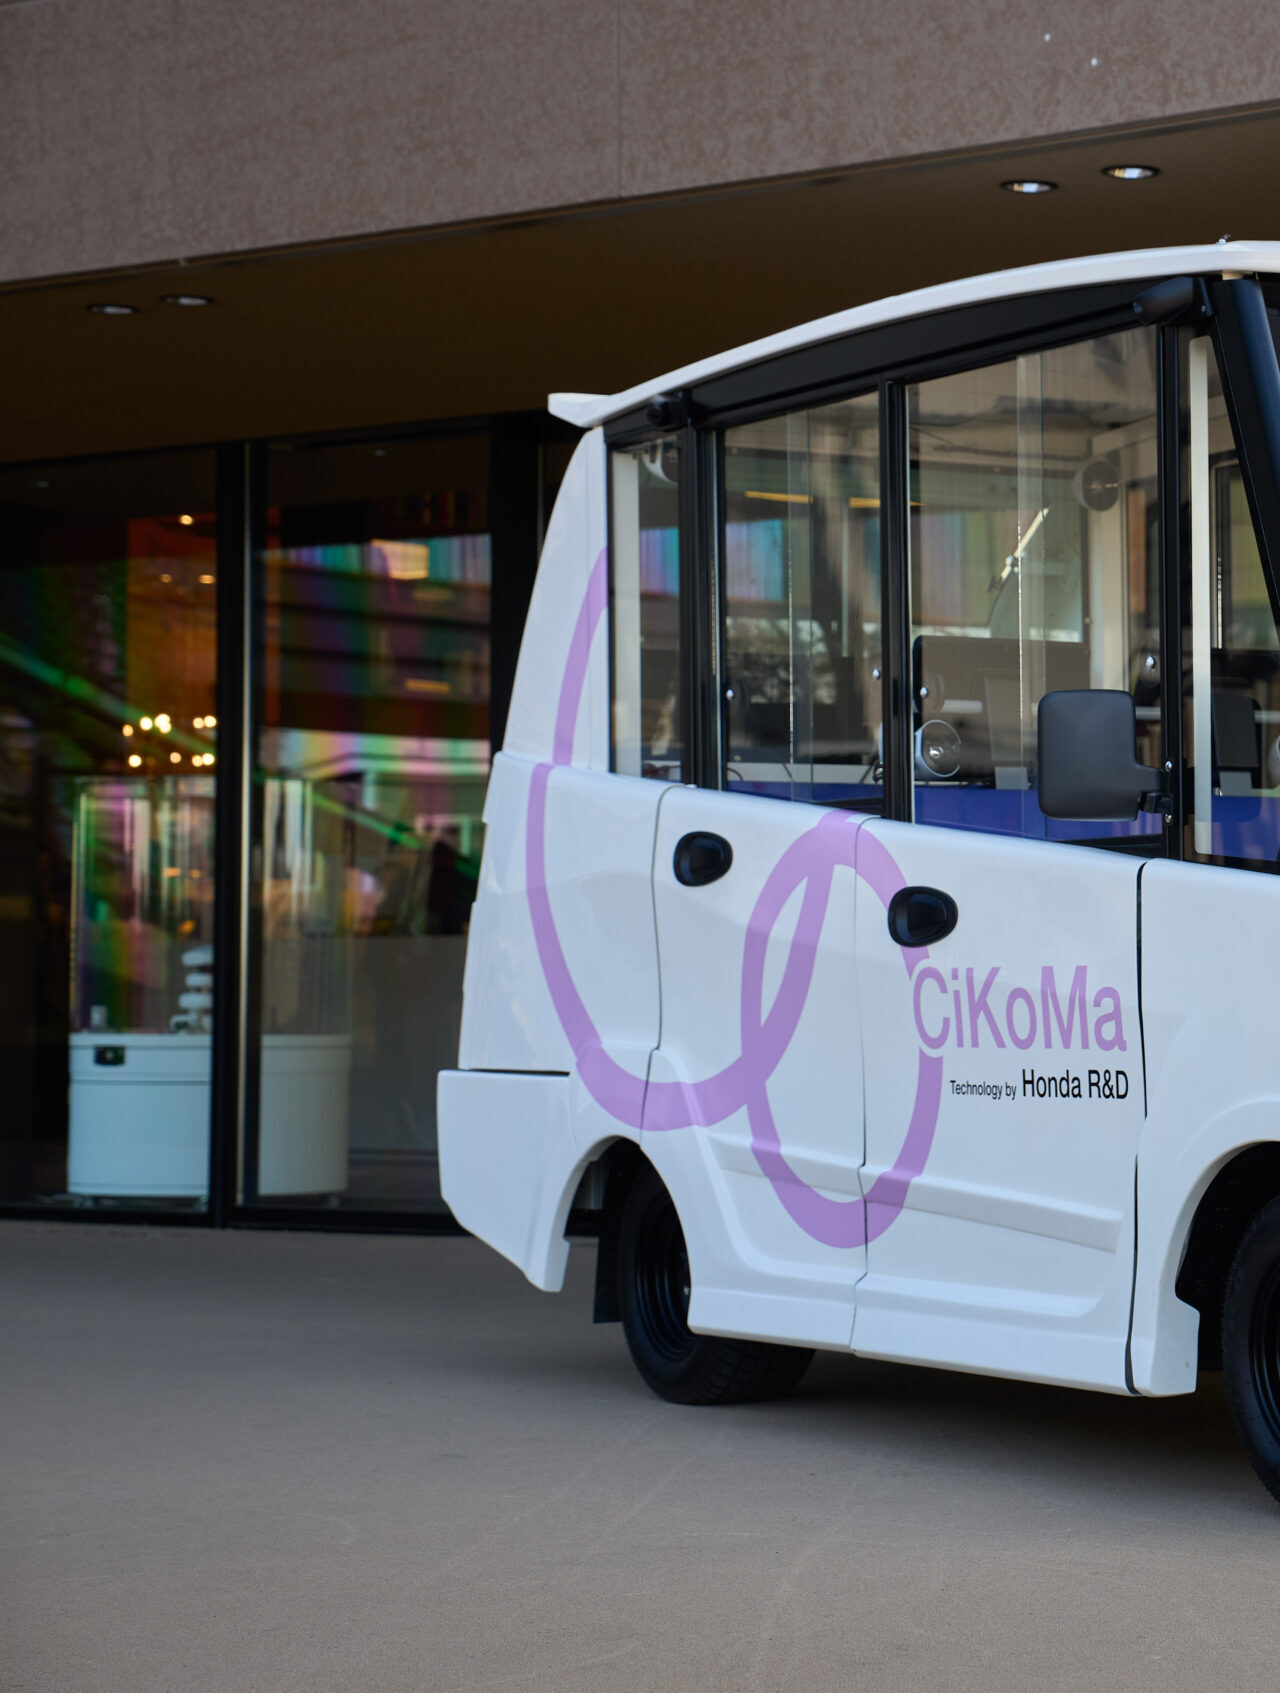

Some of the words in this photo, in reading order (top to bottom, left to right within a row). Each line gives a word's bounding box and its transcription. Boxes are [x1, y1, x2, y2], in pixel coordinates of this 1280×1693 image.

[913, 965, 1127, 1051] CiKoMa
[950, 1080, 1002, 1100] Technology
[1005, 1082, 1017, 1100] by
[1022, 1069, 1082, 1098] Honda
[1088, 1069, 1129, 1100] R&D
